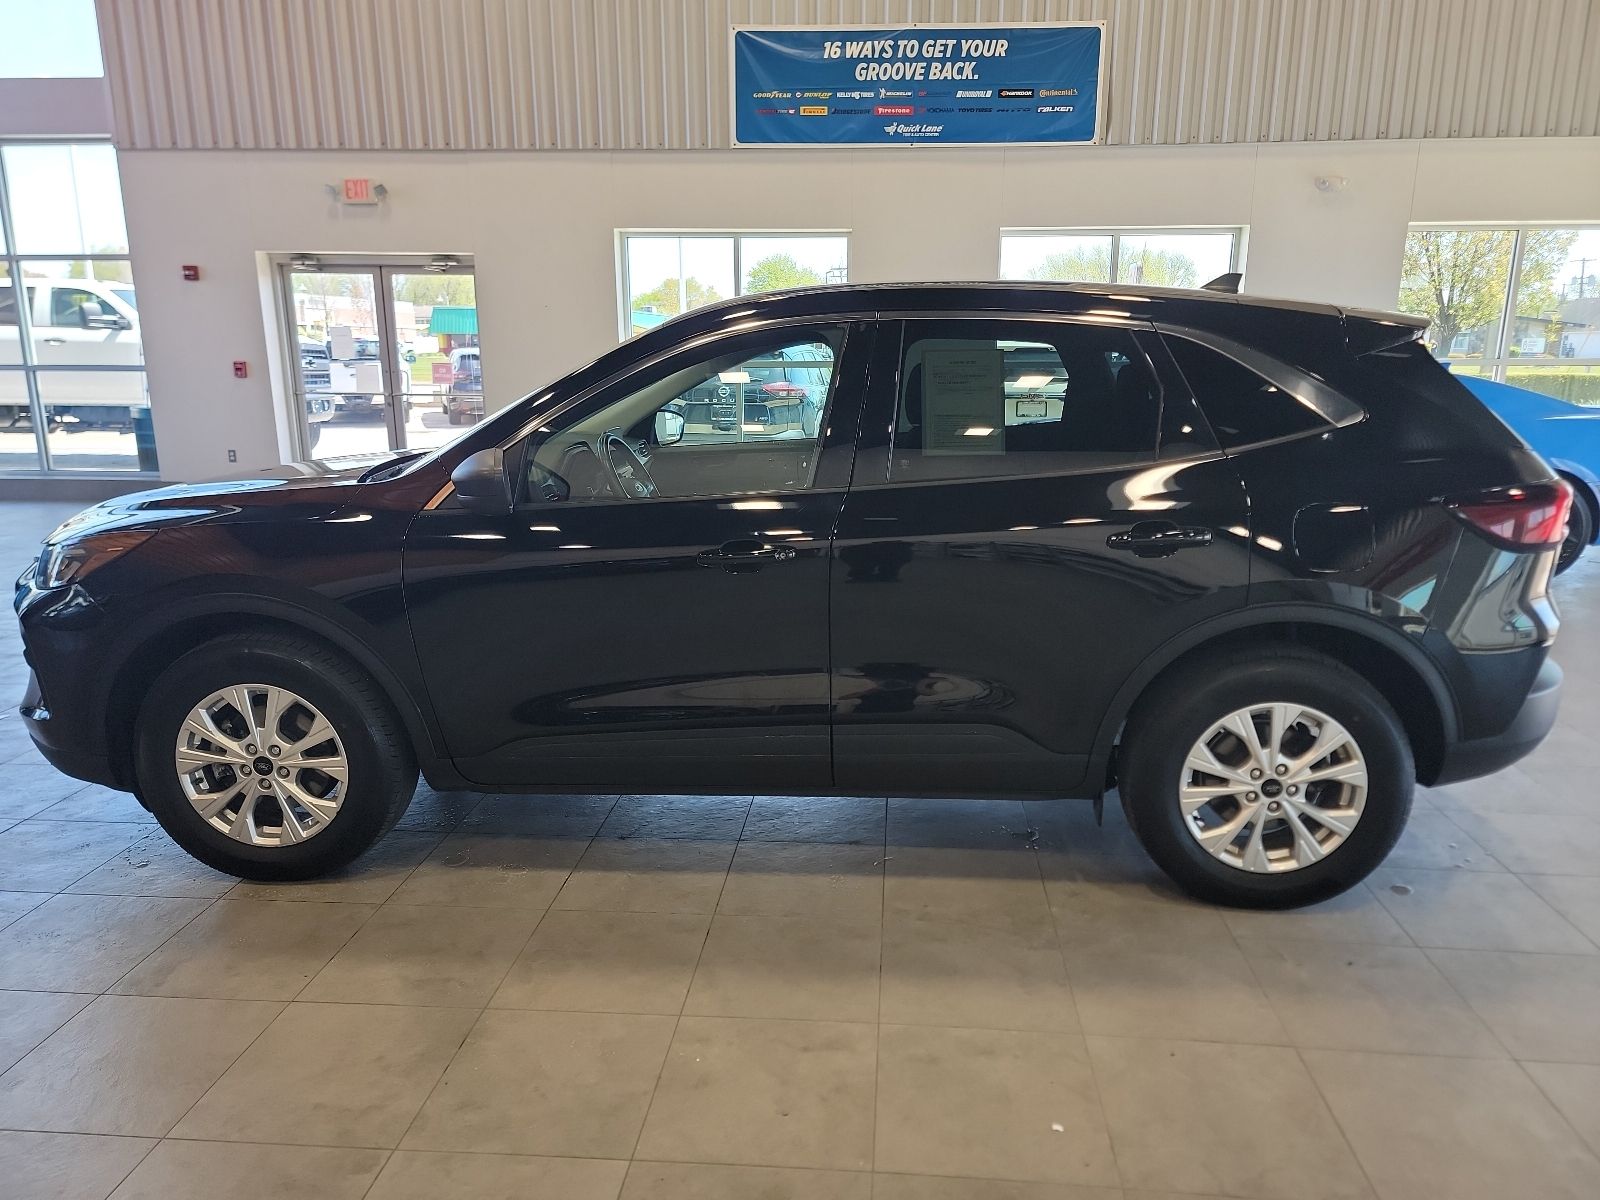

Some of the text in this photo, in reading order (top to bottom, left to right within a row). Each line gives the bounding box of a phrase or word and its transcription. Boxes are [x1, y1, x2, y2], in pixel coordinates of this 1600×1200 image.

[823, 39, 1009, 59] 16 WAYS TO GET YOUR
[855, 61, 979, 81] GROOVE BACK.
[752, 90, 793, 99] GOODYEAR
[878, 107, 911, 115] Firestone
[896, 124, 943, 133] Quick Lane
[345, 179, 369, 200] EXIT
